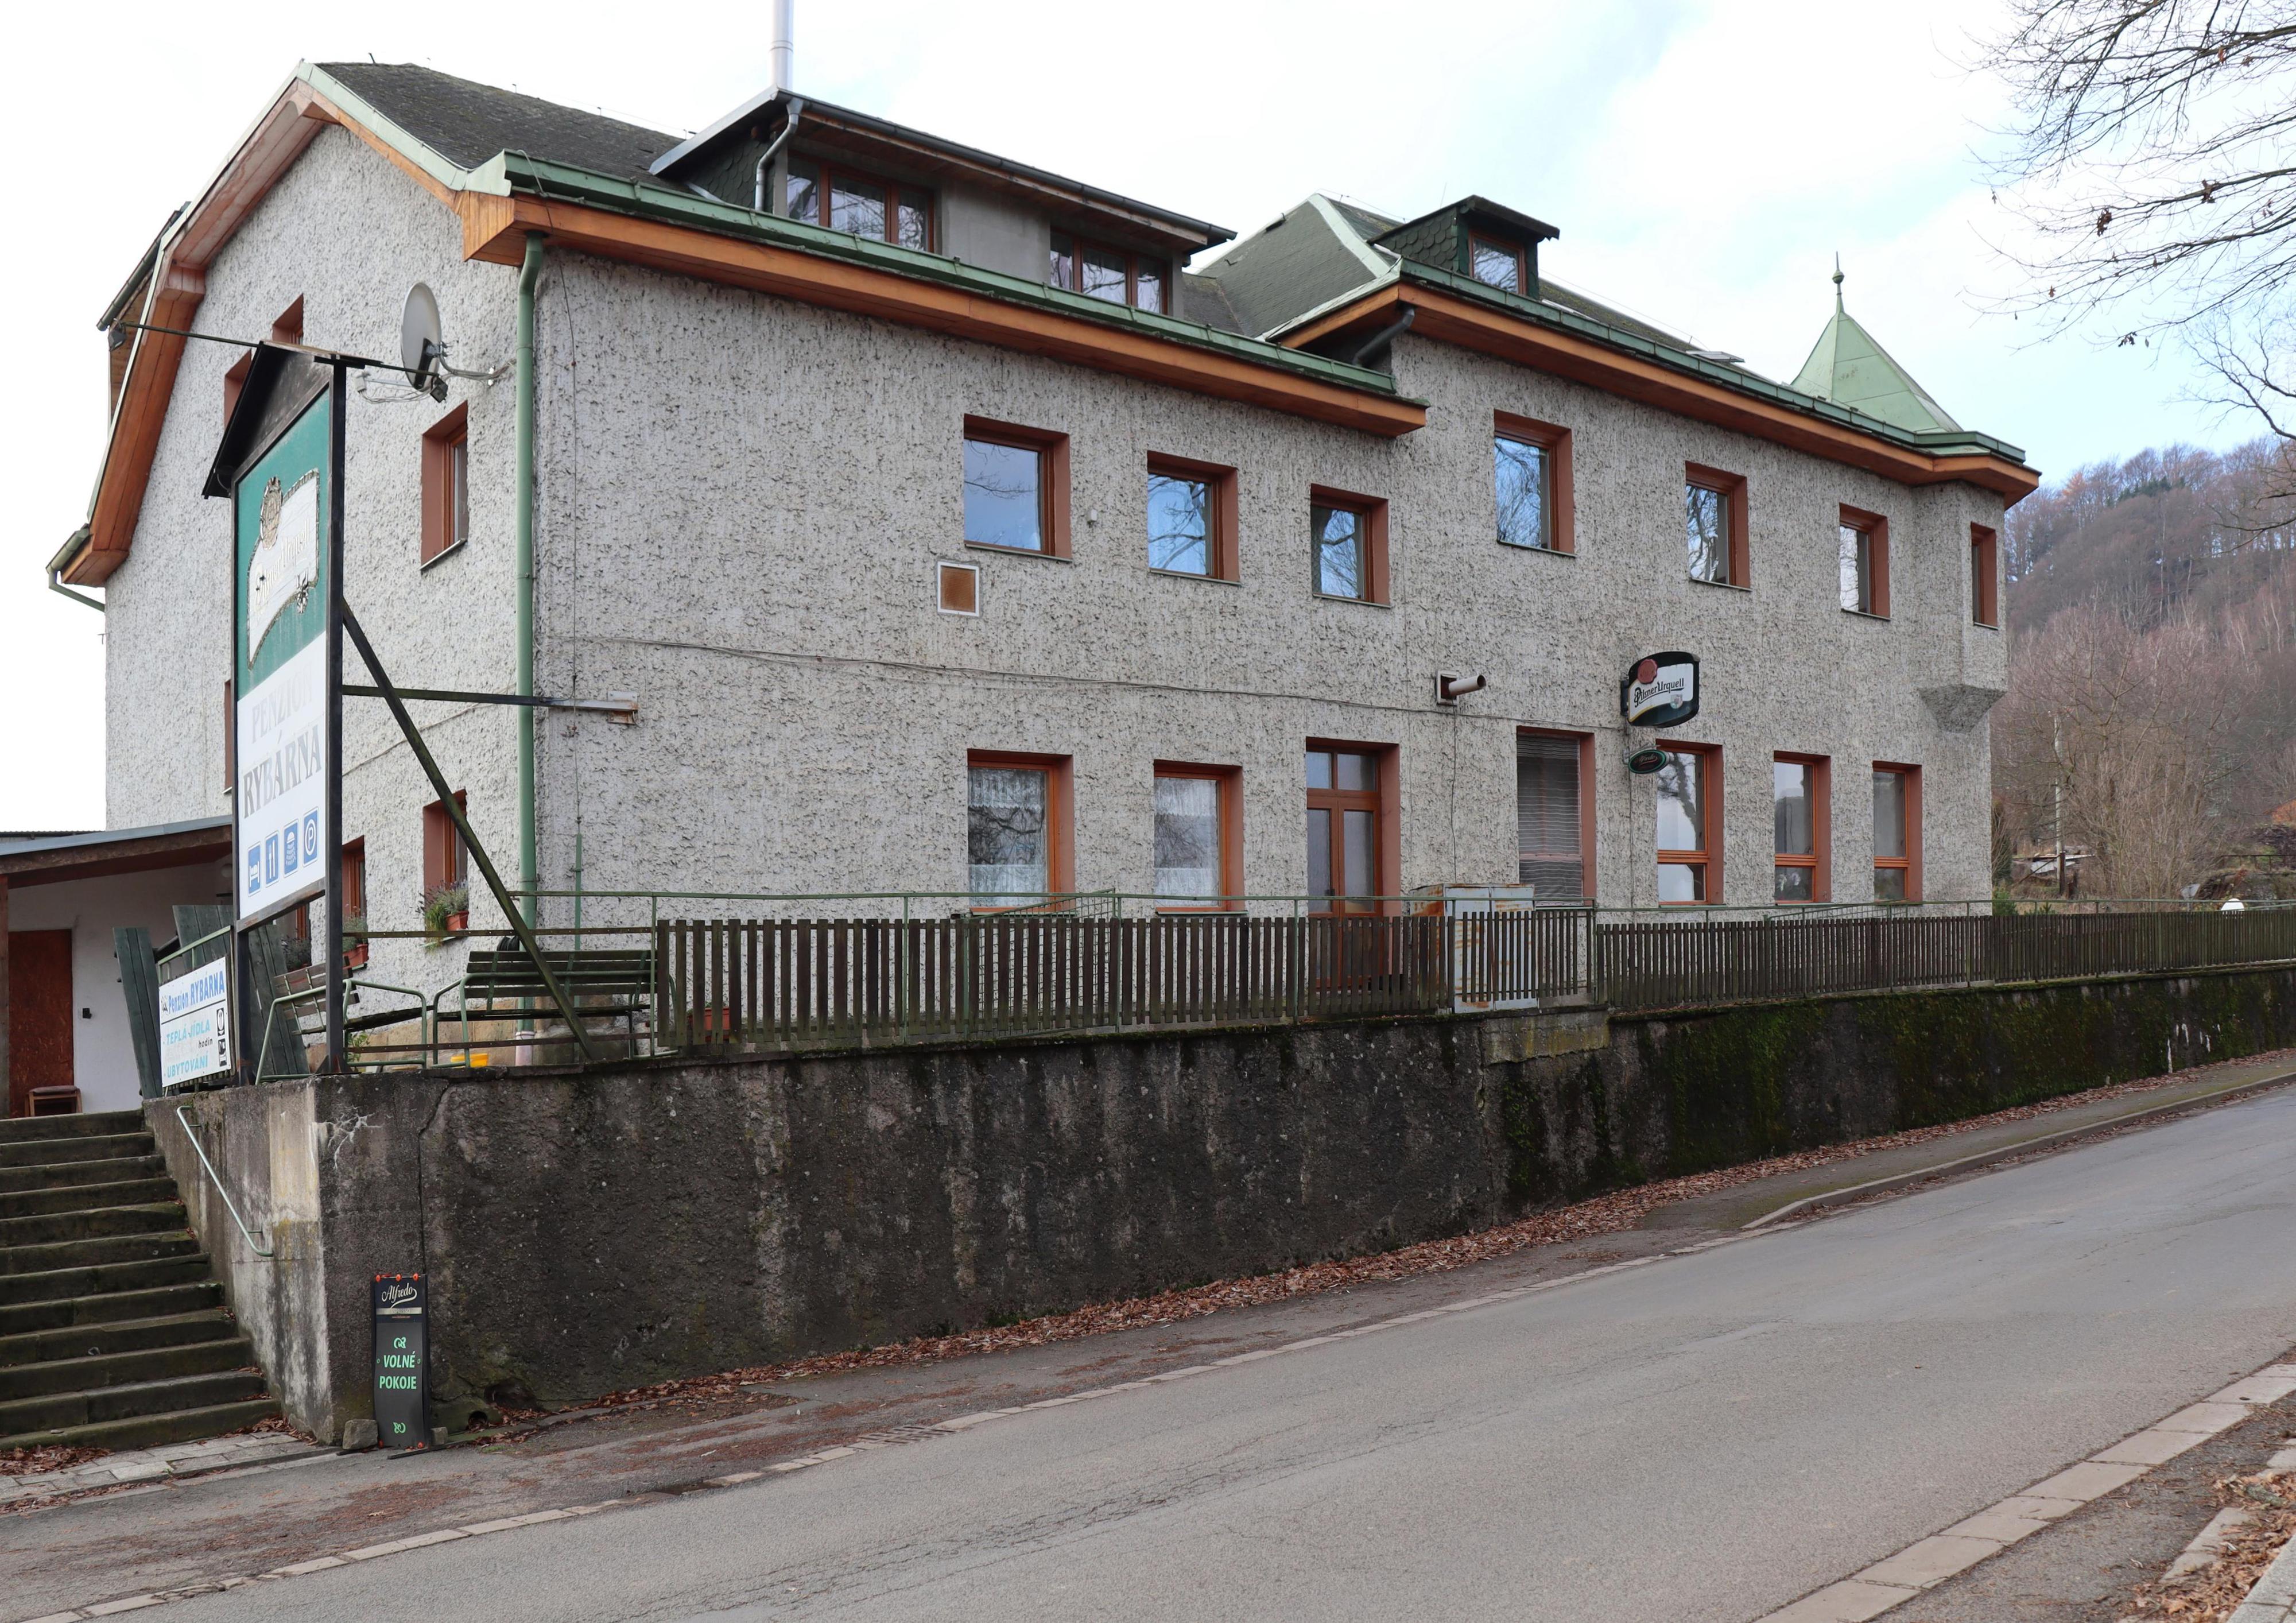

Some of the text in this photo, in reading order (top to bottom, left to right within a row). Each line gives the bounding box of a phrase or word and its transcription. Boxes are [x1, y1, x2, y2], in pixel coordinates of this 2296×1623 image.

[251, 661, 313, 744] PENZION
[1634, 678, 1684, 708] Pilsner Urquell
[243, 723, 321, 819] RYBÁRNA
[168, 970, 225, 1014] Penzion RYBÁRNA
[166, 1019, 211, 1045] TEPLÁ JÍDLA
[198, 1037, 213, 1049] hodin
[166, 1050, 208, 1078] UBYTOVÁNÍ
[381, 1282, 417, 1306] Alfredo
[383, 1351, 416, 1368] VOLNÉ
[379, 1376, 417, 1389] POKOJE
